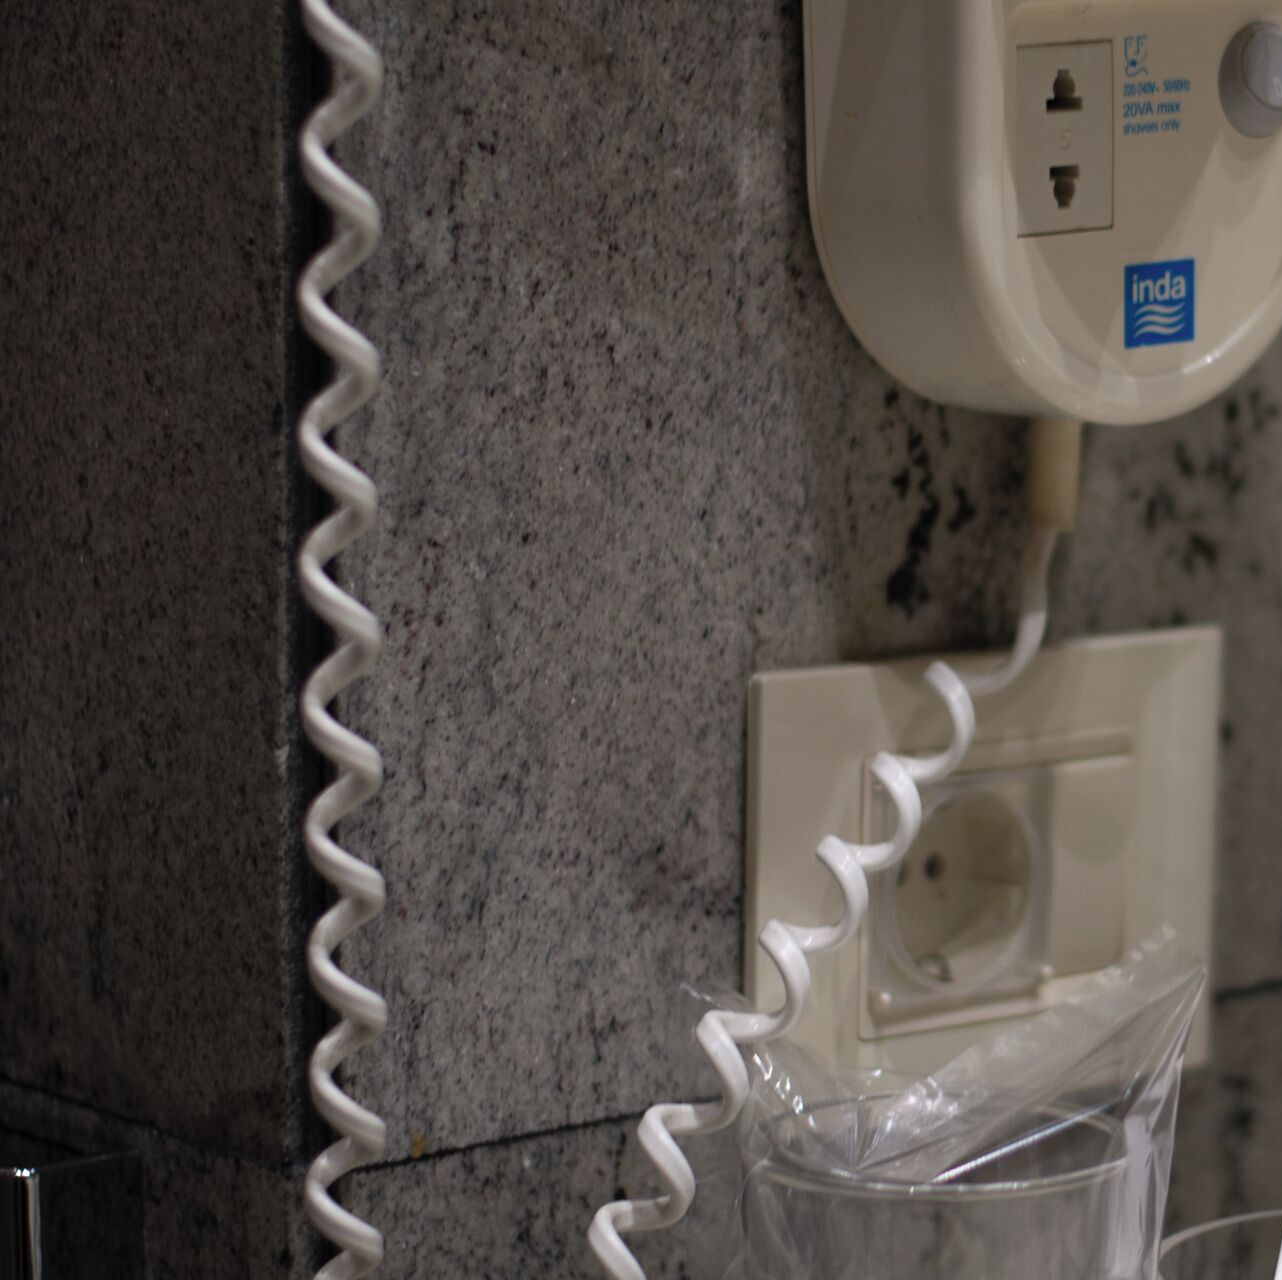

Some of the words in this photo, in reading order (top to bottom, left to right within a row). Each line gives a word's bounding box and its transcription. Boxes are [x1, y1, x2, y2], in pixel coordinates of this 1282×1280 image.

[1122, 101, 1154, 119] 20VA
[1156, 101, 1182, 116] max
[1160, 118, 1182, 133] only
[1131, 270, 1187, 304] inda
